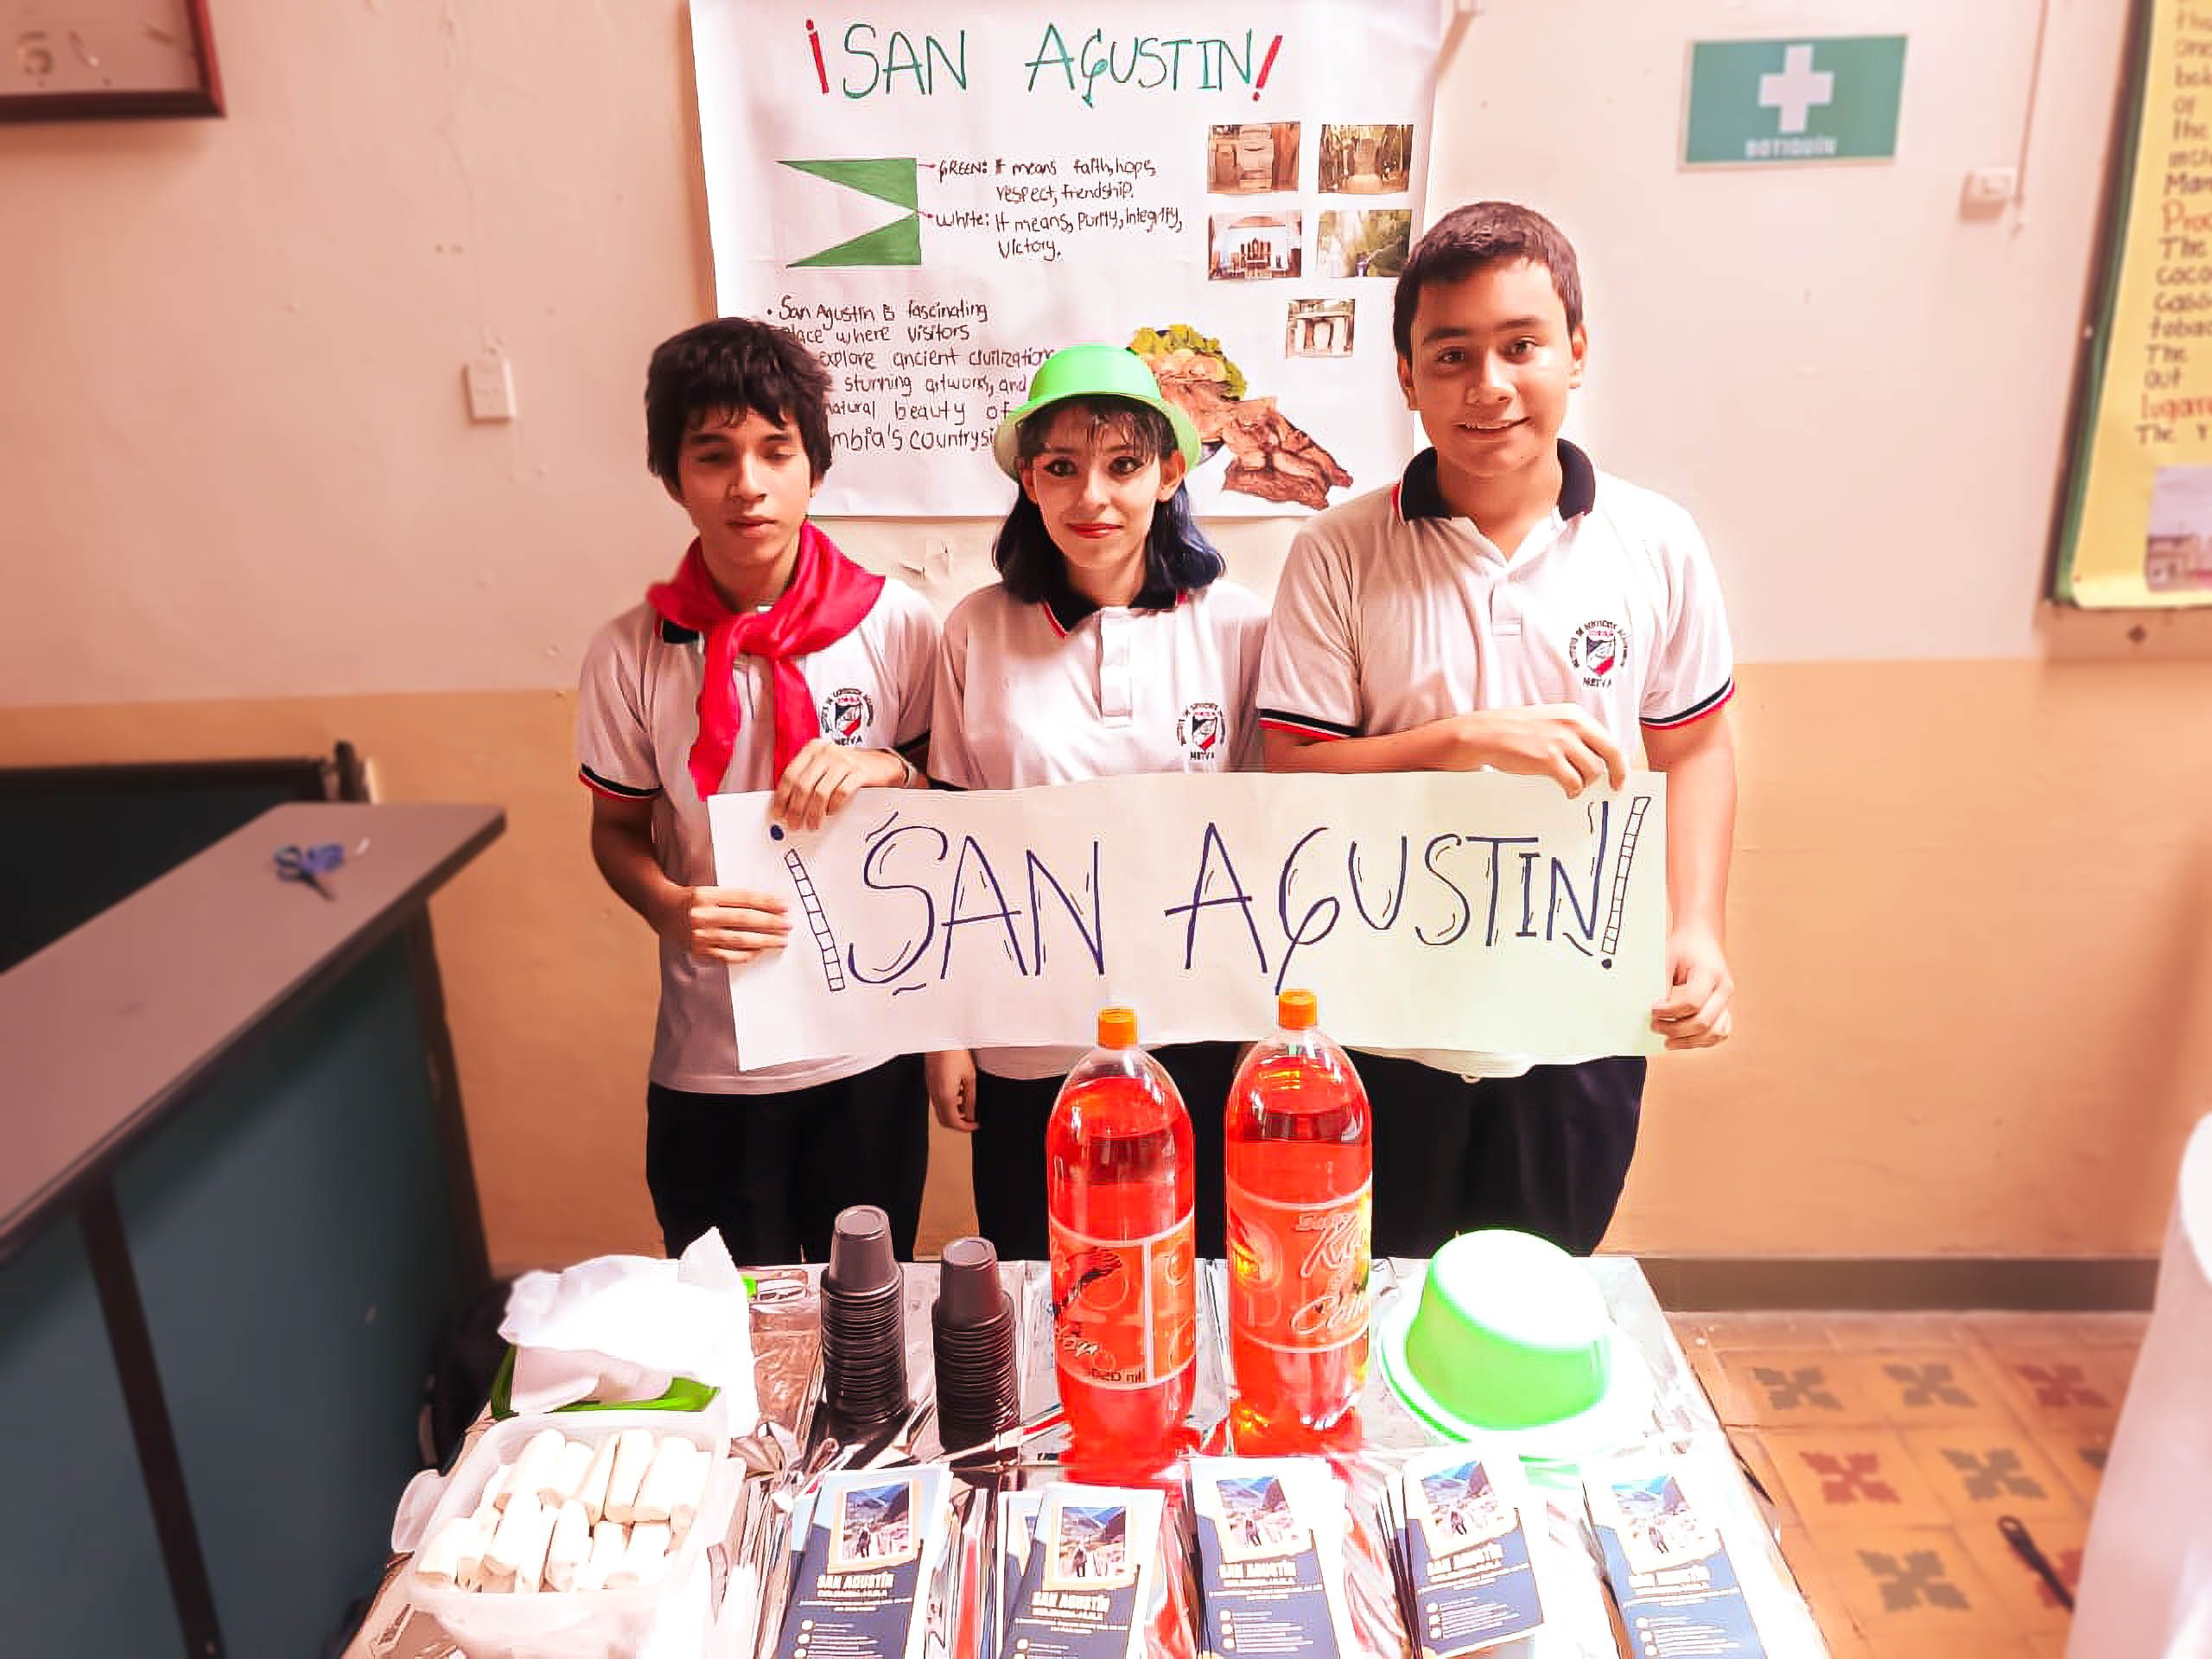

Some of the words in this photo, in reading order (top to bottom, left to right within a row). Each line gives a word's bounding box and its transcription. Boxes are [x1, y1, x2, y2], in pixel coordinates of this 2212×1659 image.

[1012, 160, 1057, 176] means
[995, 183, 1058, 207] respect,
[779, 295, 811, 321] San
[908, 300, 988, 323] fascinating
[786, 324, 825, 344] lace
[836, 325, 892, 344] where
[907, 323, 970, 343] visitors
[819, 349, 876, 370] explore
[893, 346, 962, 370] ancient
[999, 373, 1027, 395] and
[894, 401, 966, 426] beauty
[987, 400, 1010, 421] of
[830, 423, 903, 452] mbia's
[909, 427, 994, 452] countrysi
[1164, 795, 1651, 995] AGUSTIN!
